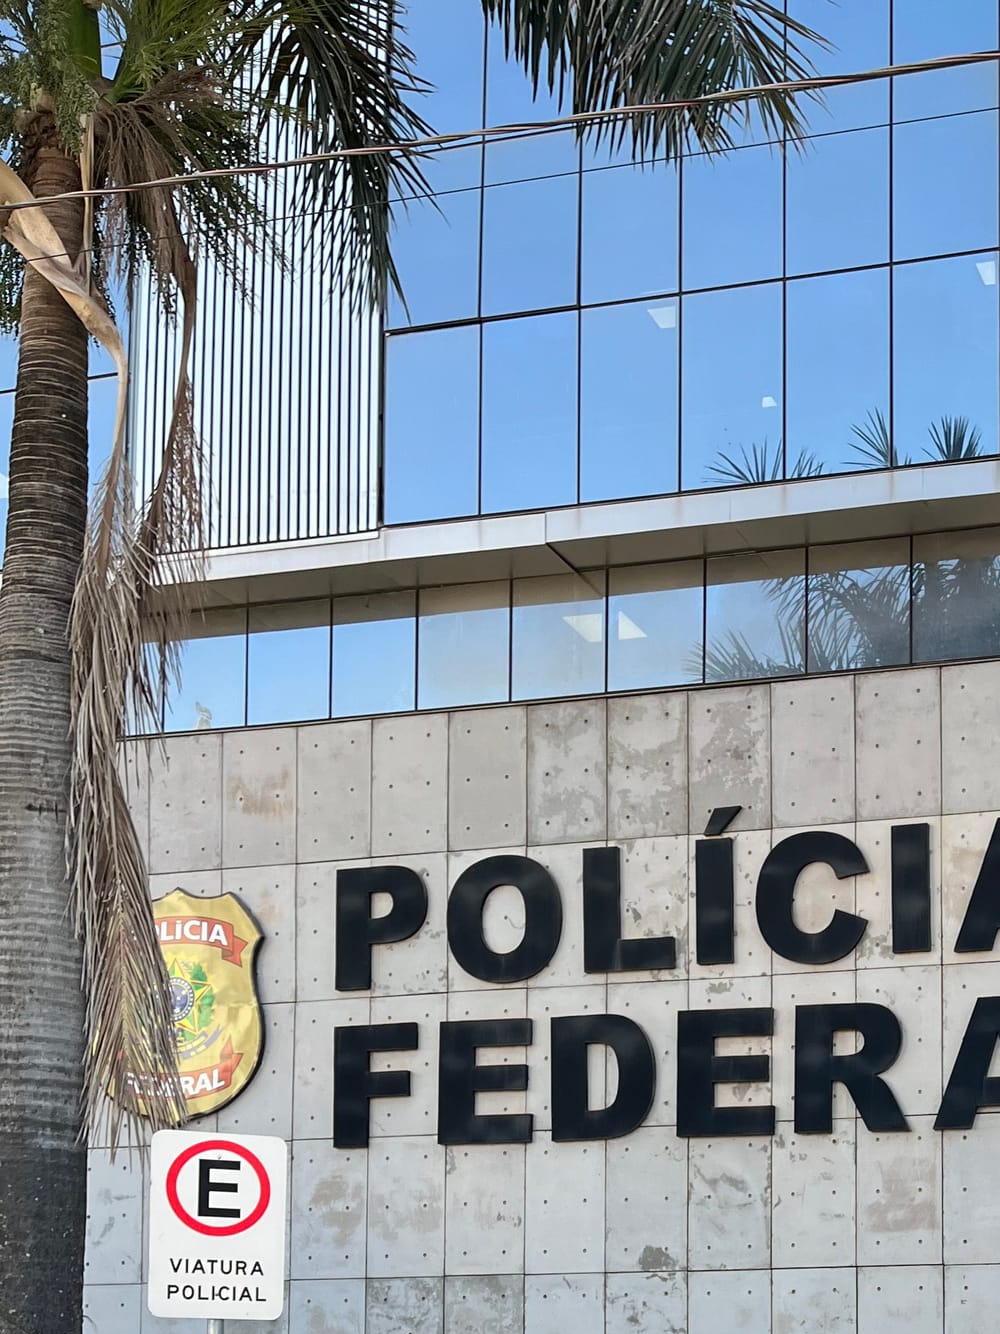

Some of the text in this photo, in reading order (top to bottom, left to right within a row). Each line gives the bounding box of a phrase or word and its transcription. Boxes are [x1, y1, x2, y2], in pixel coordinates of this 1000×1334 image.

[198, 1158, 241, 1219] E
[169, 1257, 264, 1276] VIATURA
[166, 1284, 267, 1302] POLICIAL
